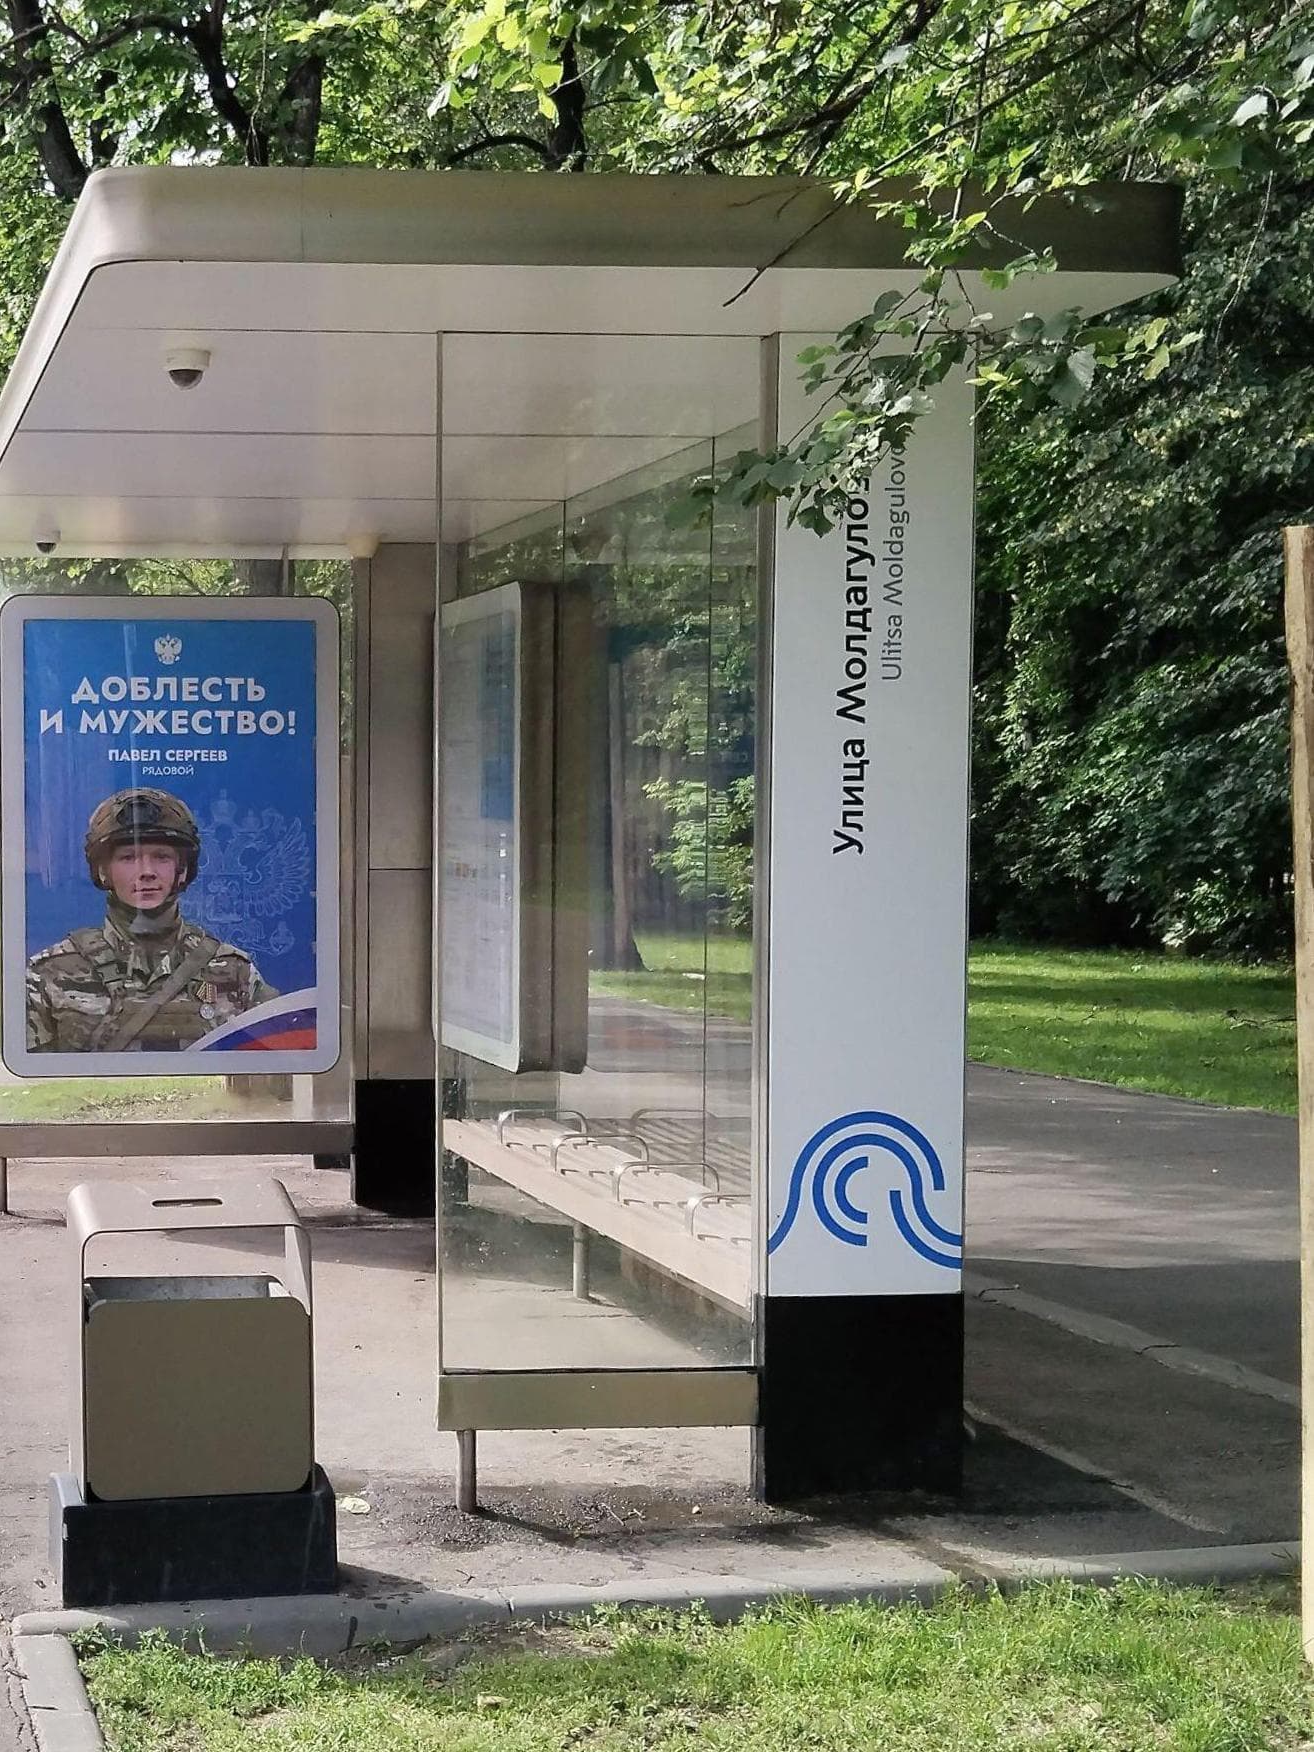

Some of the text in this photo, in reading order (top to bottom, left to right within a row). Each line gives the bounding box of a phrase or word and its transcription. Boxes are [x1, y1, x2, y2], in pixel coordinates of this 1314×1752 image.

[880, 445, 910, 681] Ulitsa Moldagulovo
[833, 476, 876, 855] Улица Молдагуло
[71, 676, 266, 704] ДОБЛЕСТЬ
[39, 709, 297, 735] И МУЖЕСТВО!
[108, 749, 229, 762] ПАВЕЛ СЕРГЕЕВ
[142, 764, 195, 777] РЯДОВОЙ
